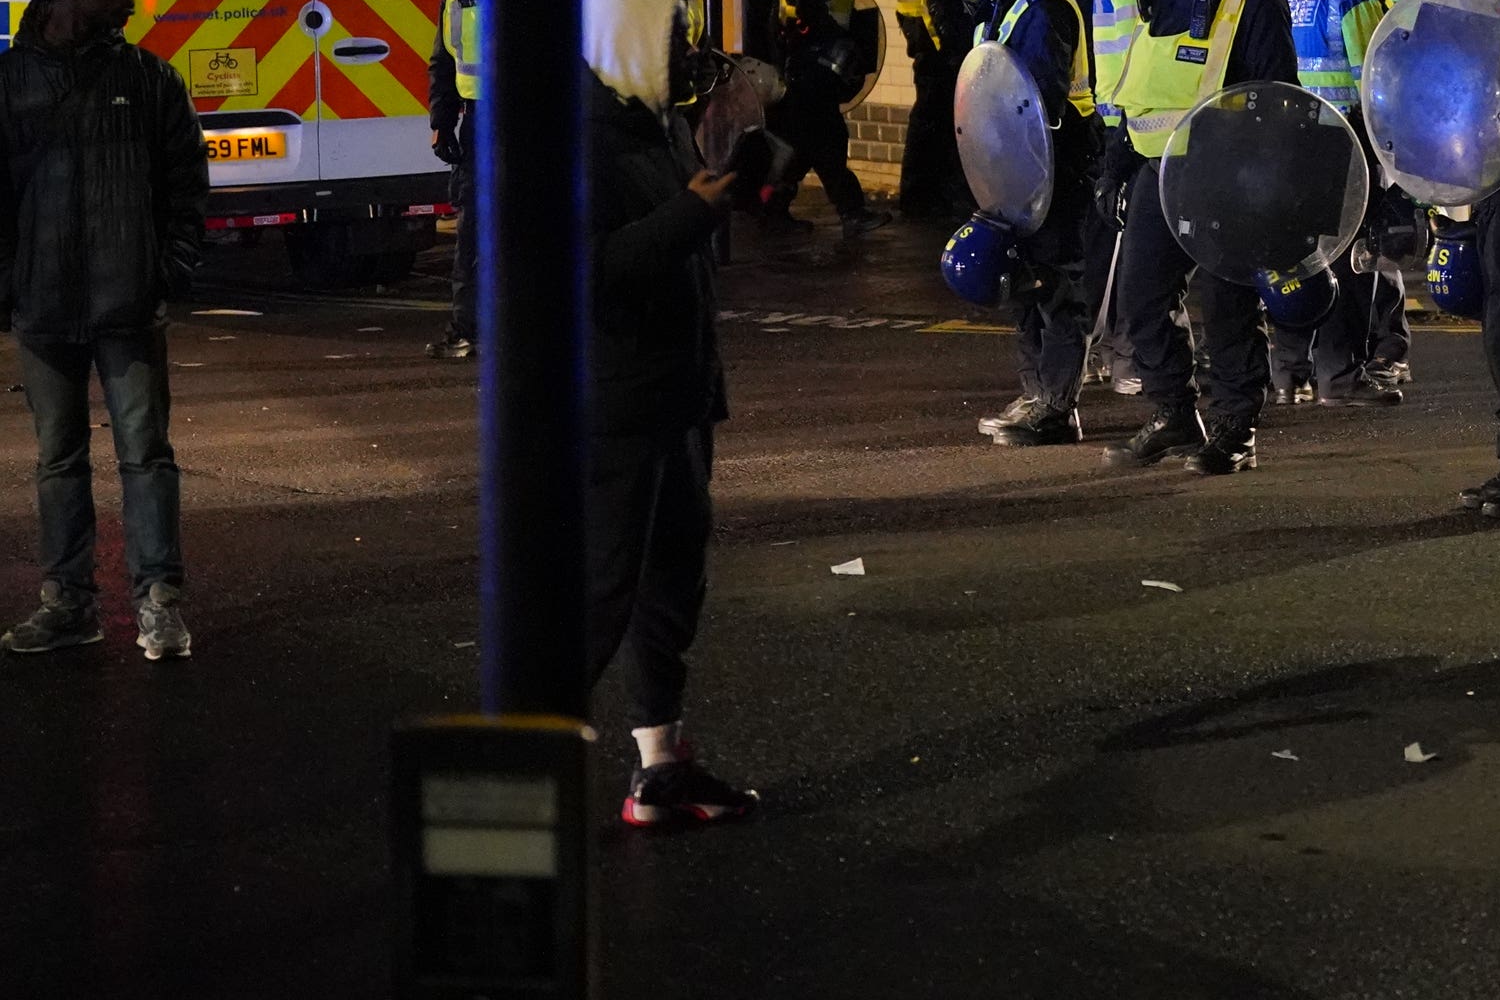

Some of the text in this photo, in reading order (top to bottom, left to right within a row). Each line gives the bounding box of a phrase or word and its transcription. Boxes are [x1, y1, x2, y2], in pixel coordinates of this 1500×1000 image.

[237, 137, 277, 157] FML
[1426, 269, 1441, 282] MP
[1281, 278, 1303, 295] MP
